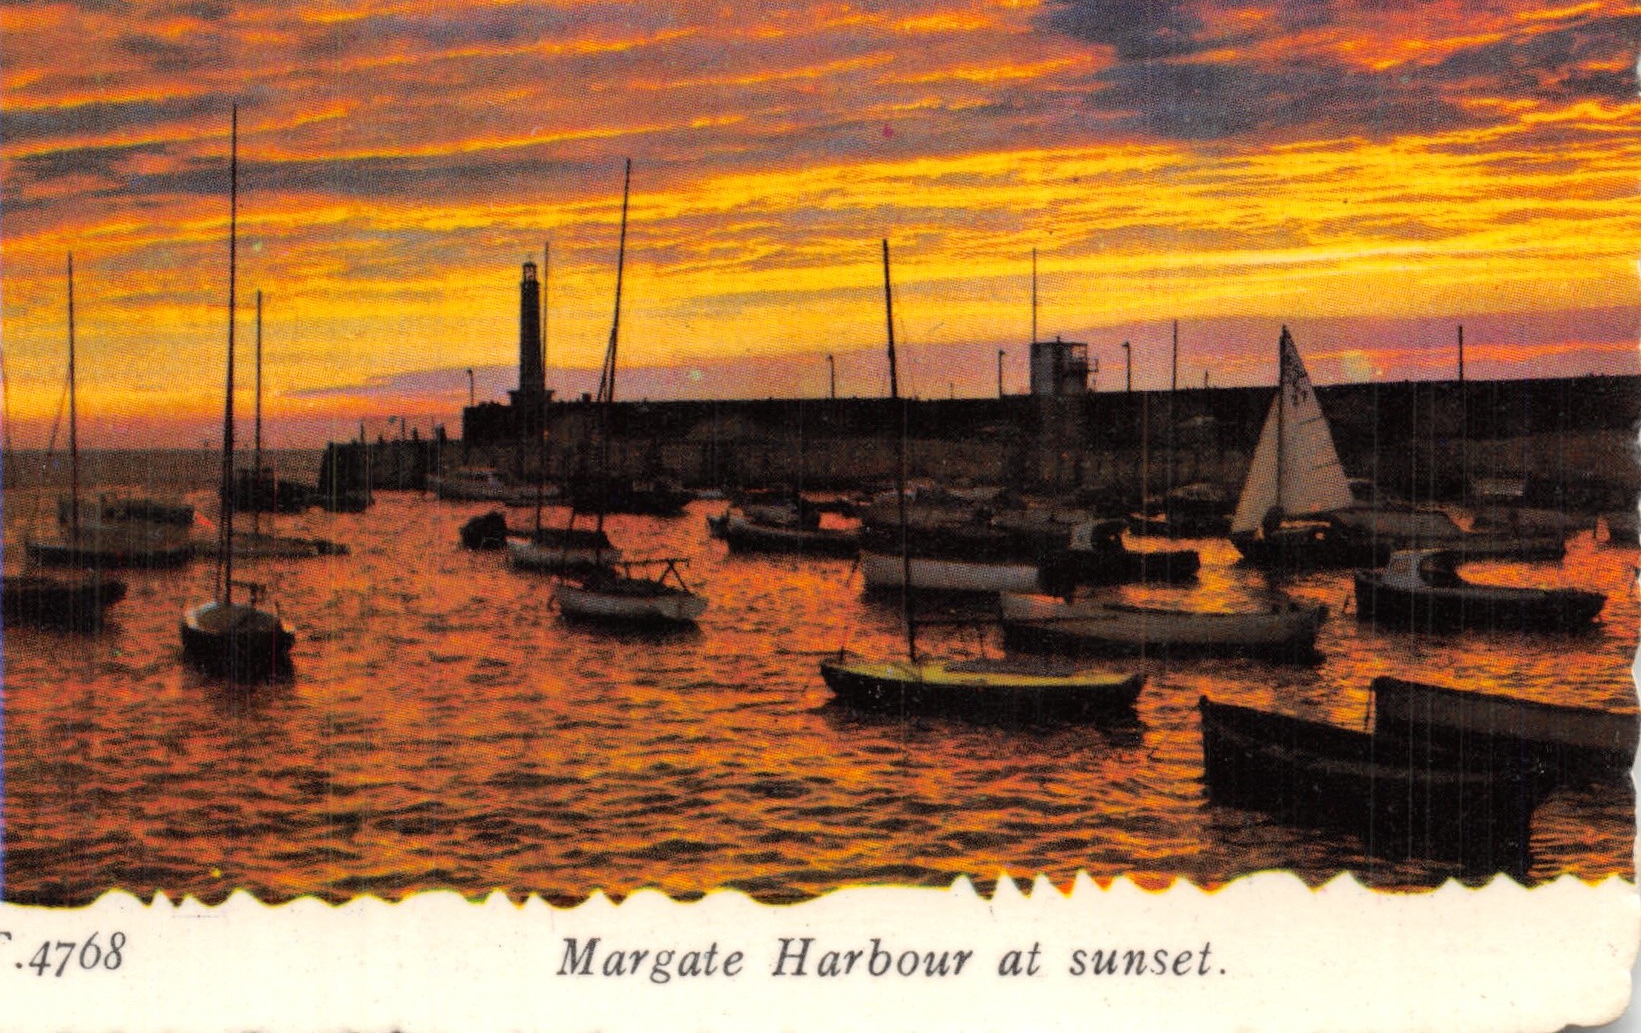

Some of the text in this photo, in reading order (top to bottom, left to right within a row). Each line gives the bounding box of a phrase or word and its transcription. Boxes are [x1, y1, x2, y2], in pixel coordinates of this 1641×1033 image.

[557, 937, 1227, 986] Margate Harbour at sunset.
